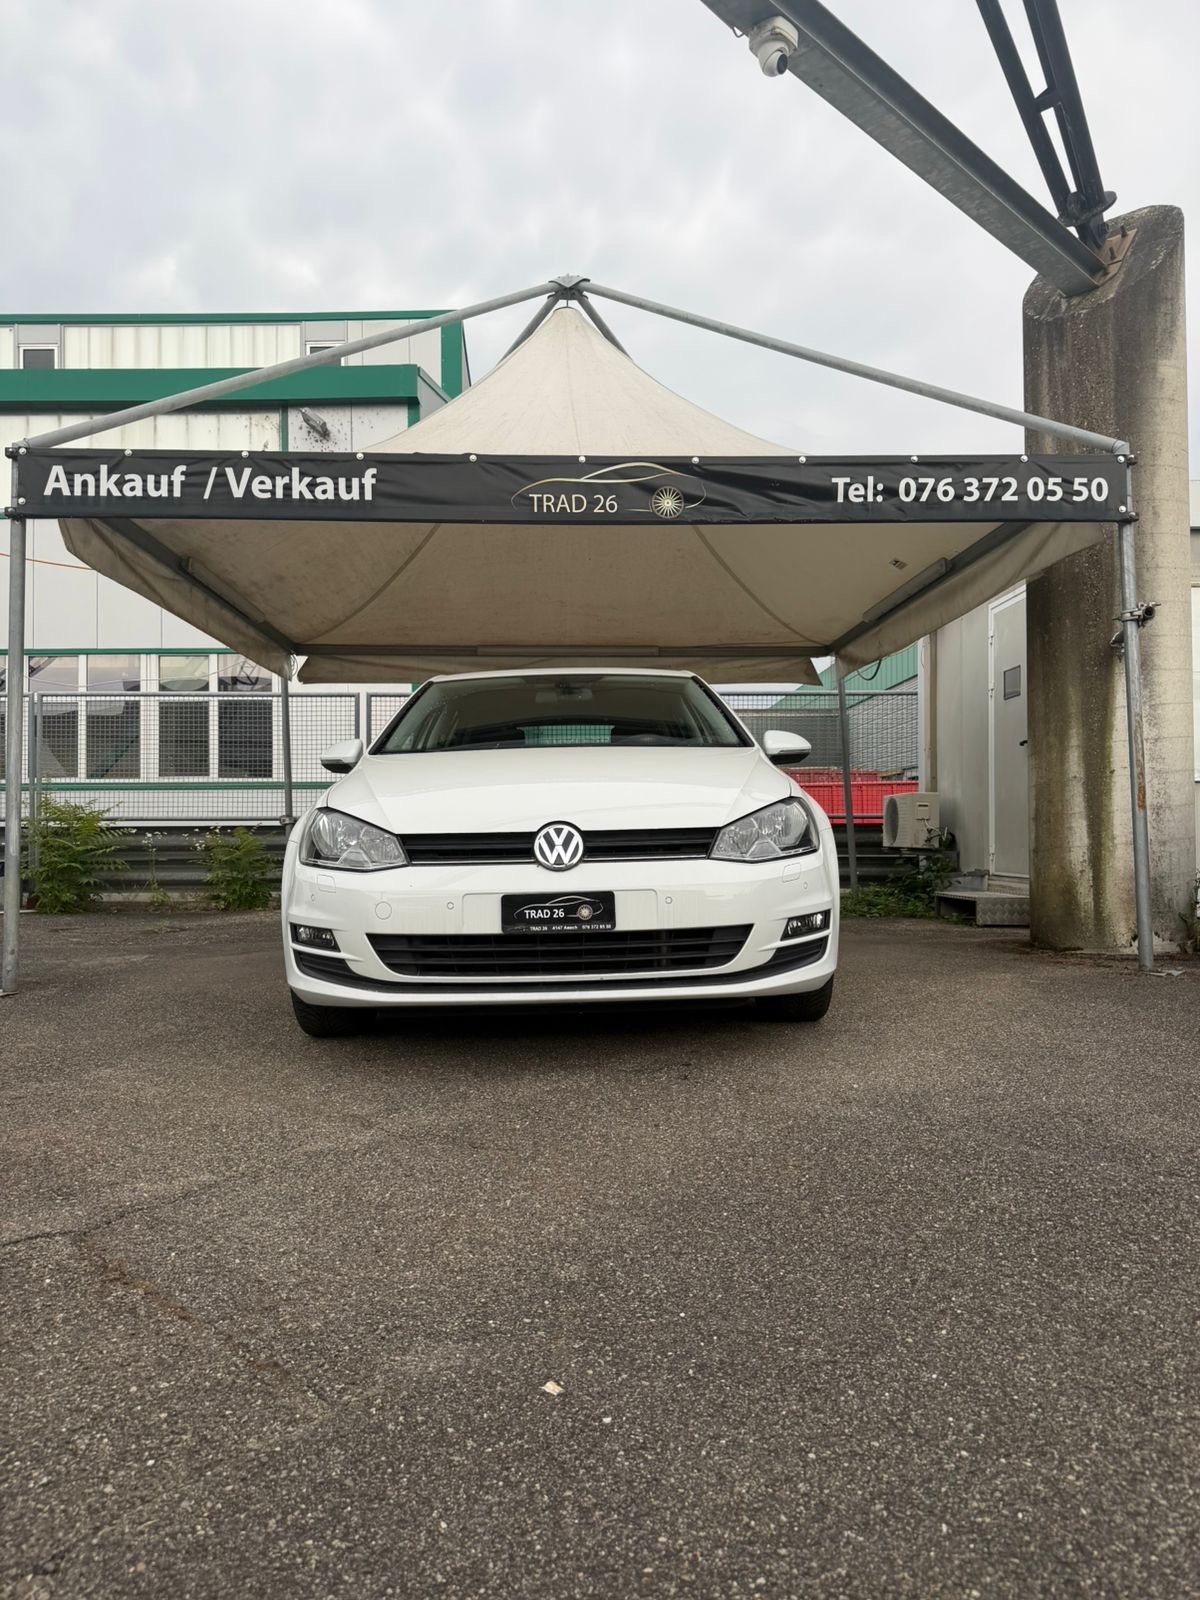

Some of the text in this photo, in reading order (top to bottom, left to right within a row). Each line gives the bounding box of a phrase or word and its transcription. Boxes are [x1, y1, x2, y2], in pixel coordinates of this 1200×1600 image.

[43, 464, 187, 498] Ankauf
[831, 475, 1109, 503] Tel: 076 372 05 50
[529, 494, 618, 513] TRAD 26
[534, 824, 583, 868] VW
[524, 908, 565, 919] TRAD 26
